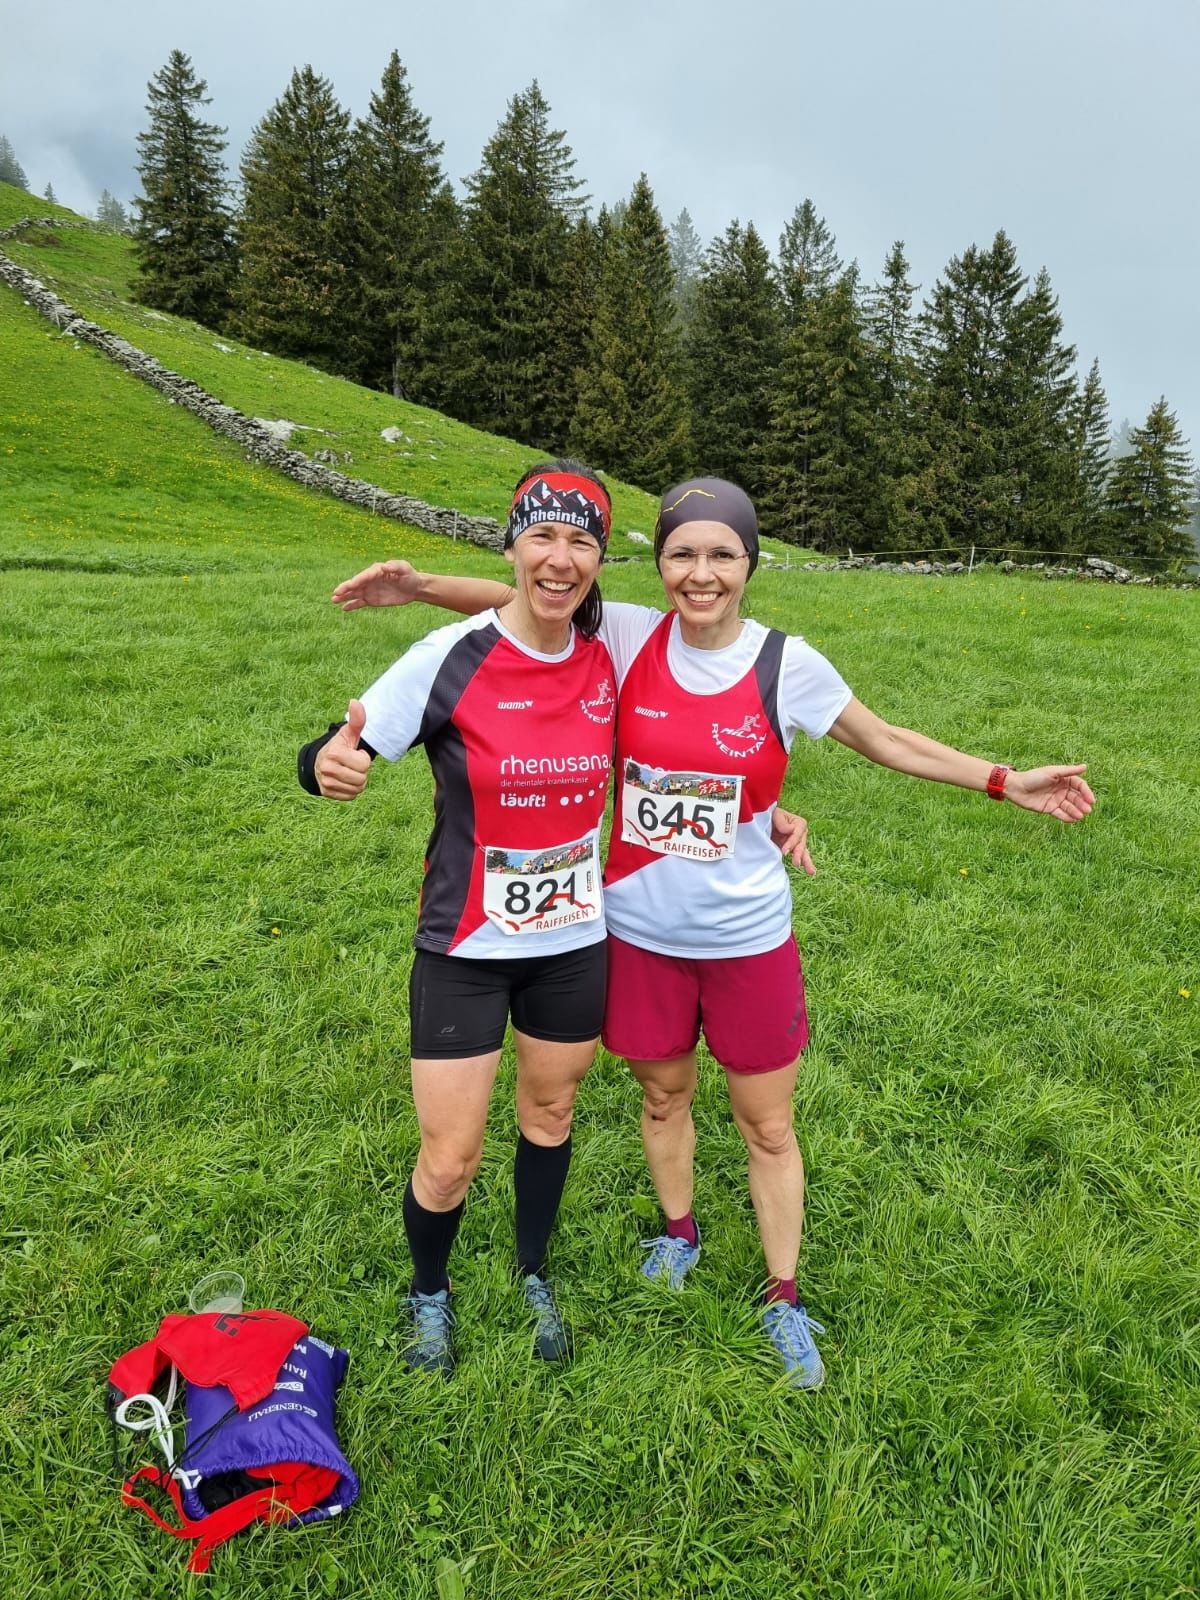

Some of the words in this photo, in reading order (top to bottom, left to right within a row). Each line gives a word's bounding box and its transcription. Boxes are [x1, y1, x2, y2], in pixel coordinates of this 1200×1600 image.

[530, 509, 590, 530] Rheintal
[497, 701, 526, 710] wams
[711, 723, 767, 758] RHEINTAL
[720, 727, 758, 740] MILA
[501, 754, 609, 775] rhenusana
[501, 779, 512, 788] die
[514, 777, 546, 787] rheintaler
[547, 776, 589, 785] krankenkasse
[500, 793, 546, 808] läuft!
[638, 797, 715, 840] 645
[663, 842, 722, 858] RAIFFEISEN
[504, 871, 576, 915] 821
[536, 909, 589, 930] RAIFFEISEN
[248, 1403, 303, 1422] GENERALI
